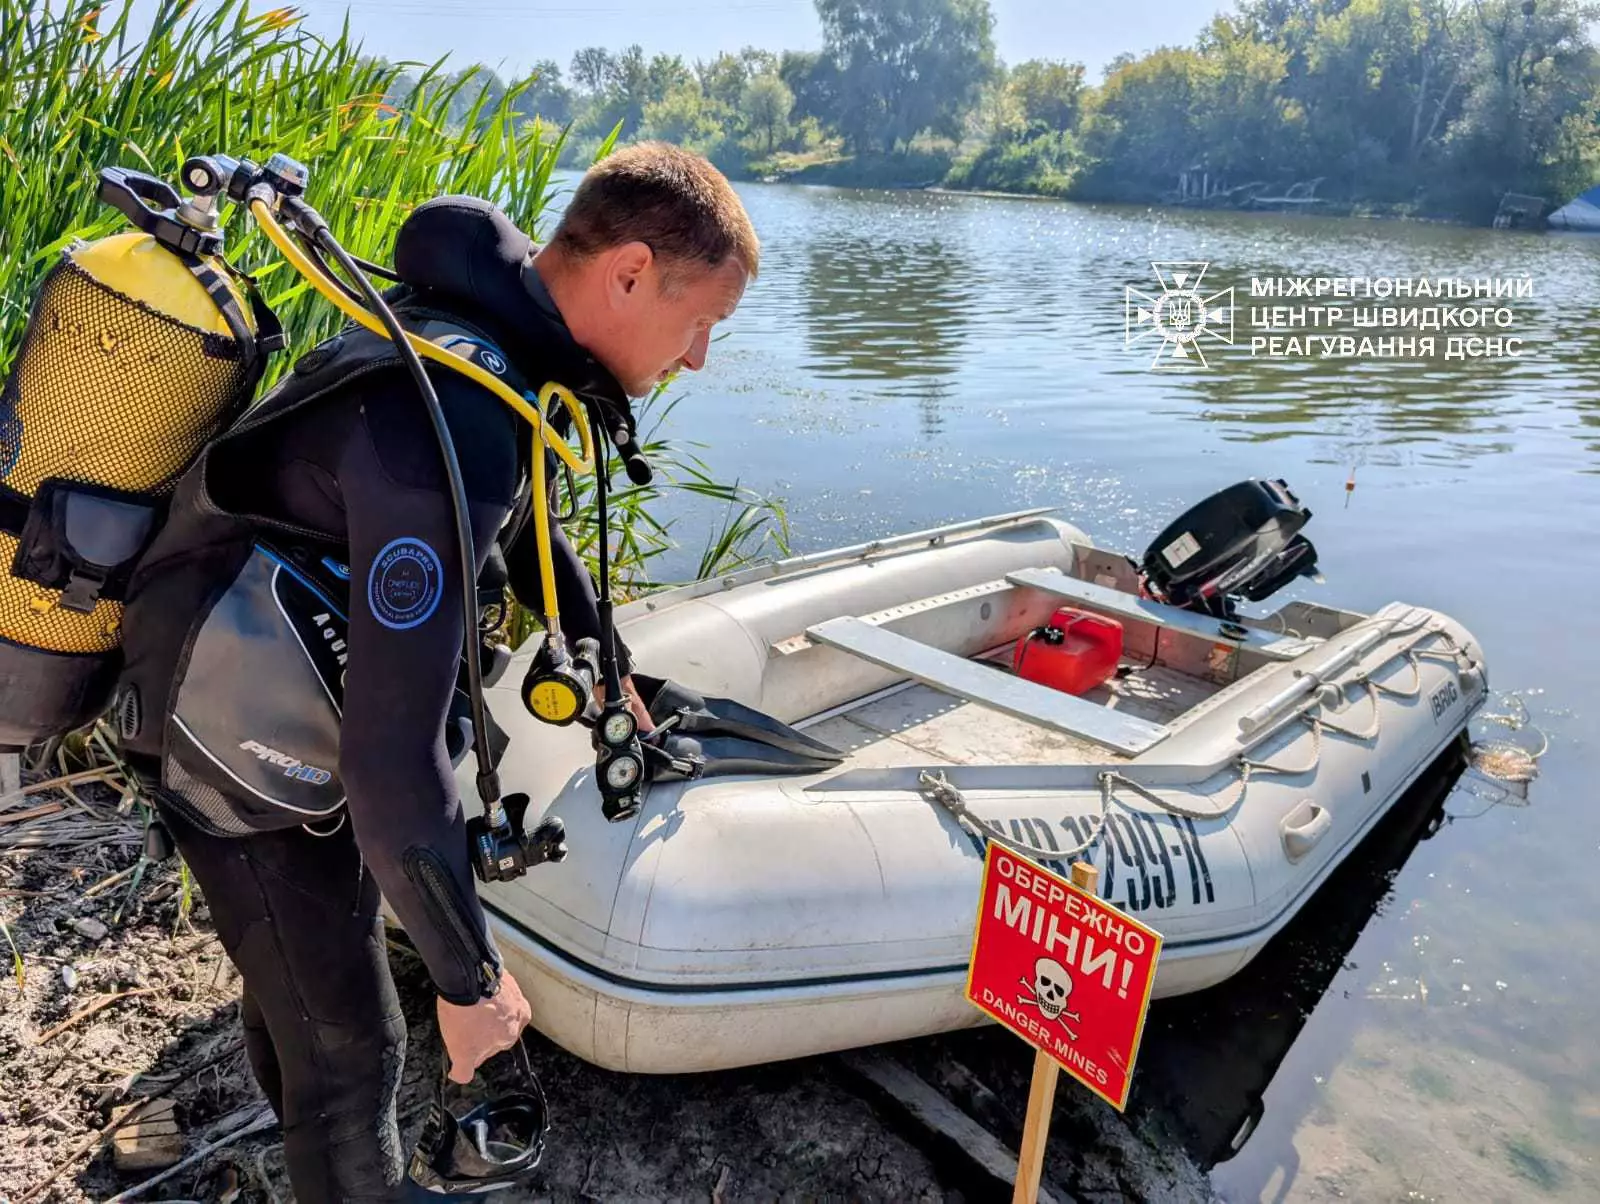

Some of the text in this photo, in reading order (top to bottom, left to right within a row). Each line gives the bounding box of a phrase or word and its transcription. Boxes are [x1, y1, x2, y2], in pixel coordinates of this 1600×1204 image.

[1432, 681, 1458, 718] BRIG
[993, 883, 1134, 1000] МІНИ!
[996, 855, 1145, 956] ОБЕРЕЖНО
[1054, 1037, 1108, 1086] MINES
